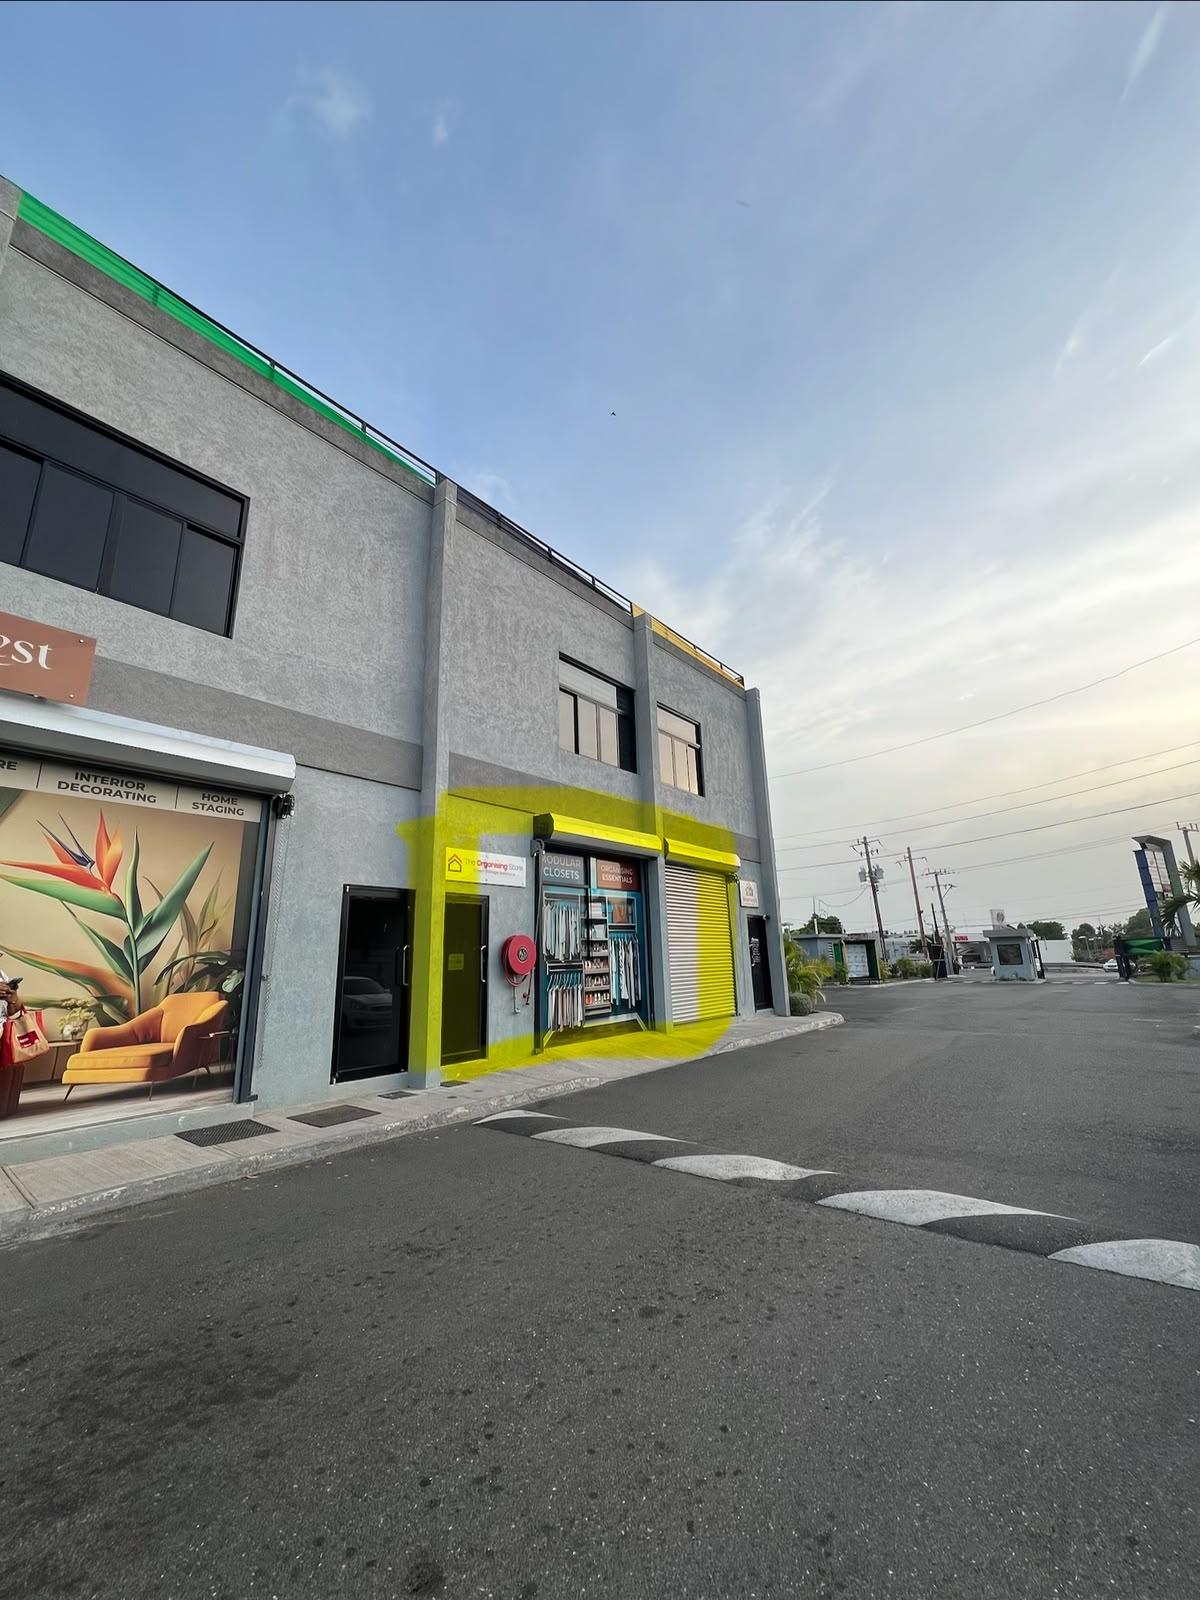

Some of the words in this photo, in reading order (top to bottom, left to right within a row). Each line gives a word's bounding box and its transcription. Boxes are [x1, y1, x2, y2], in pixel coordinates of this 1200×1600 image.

[74, 771, 146, 791] INTERIOR
[57, 781, 157, 803] DECORATING
[201, 793, 238, 806] HOME
[191, 802, 245, 816] STAGING
[477, 860, 508, 871] Organising
[543, 866, 580, 880] CLOSETS
[601, 873, 633, 884] ESSENTIALS
